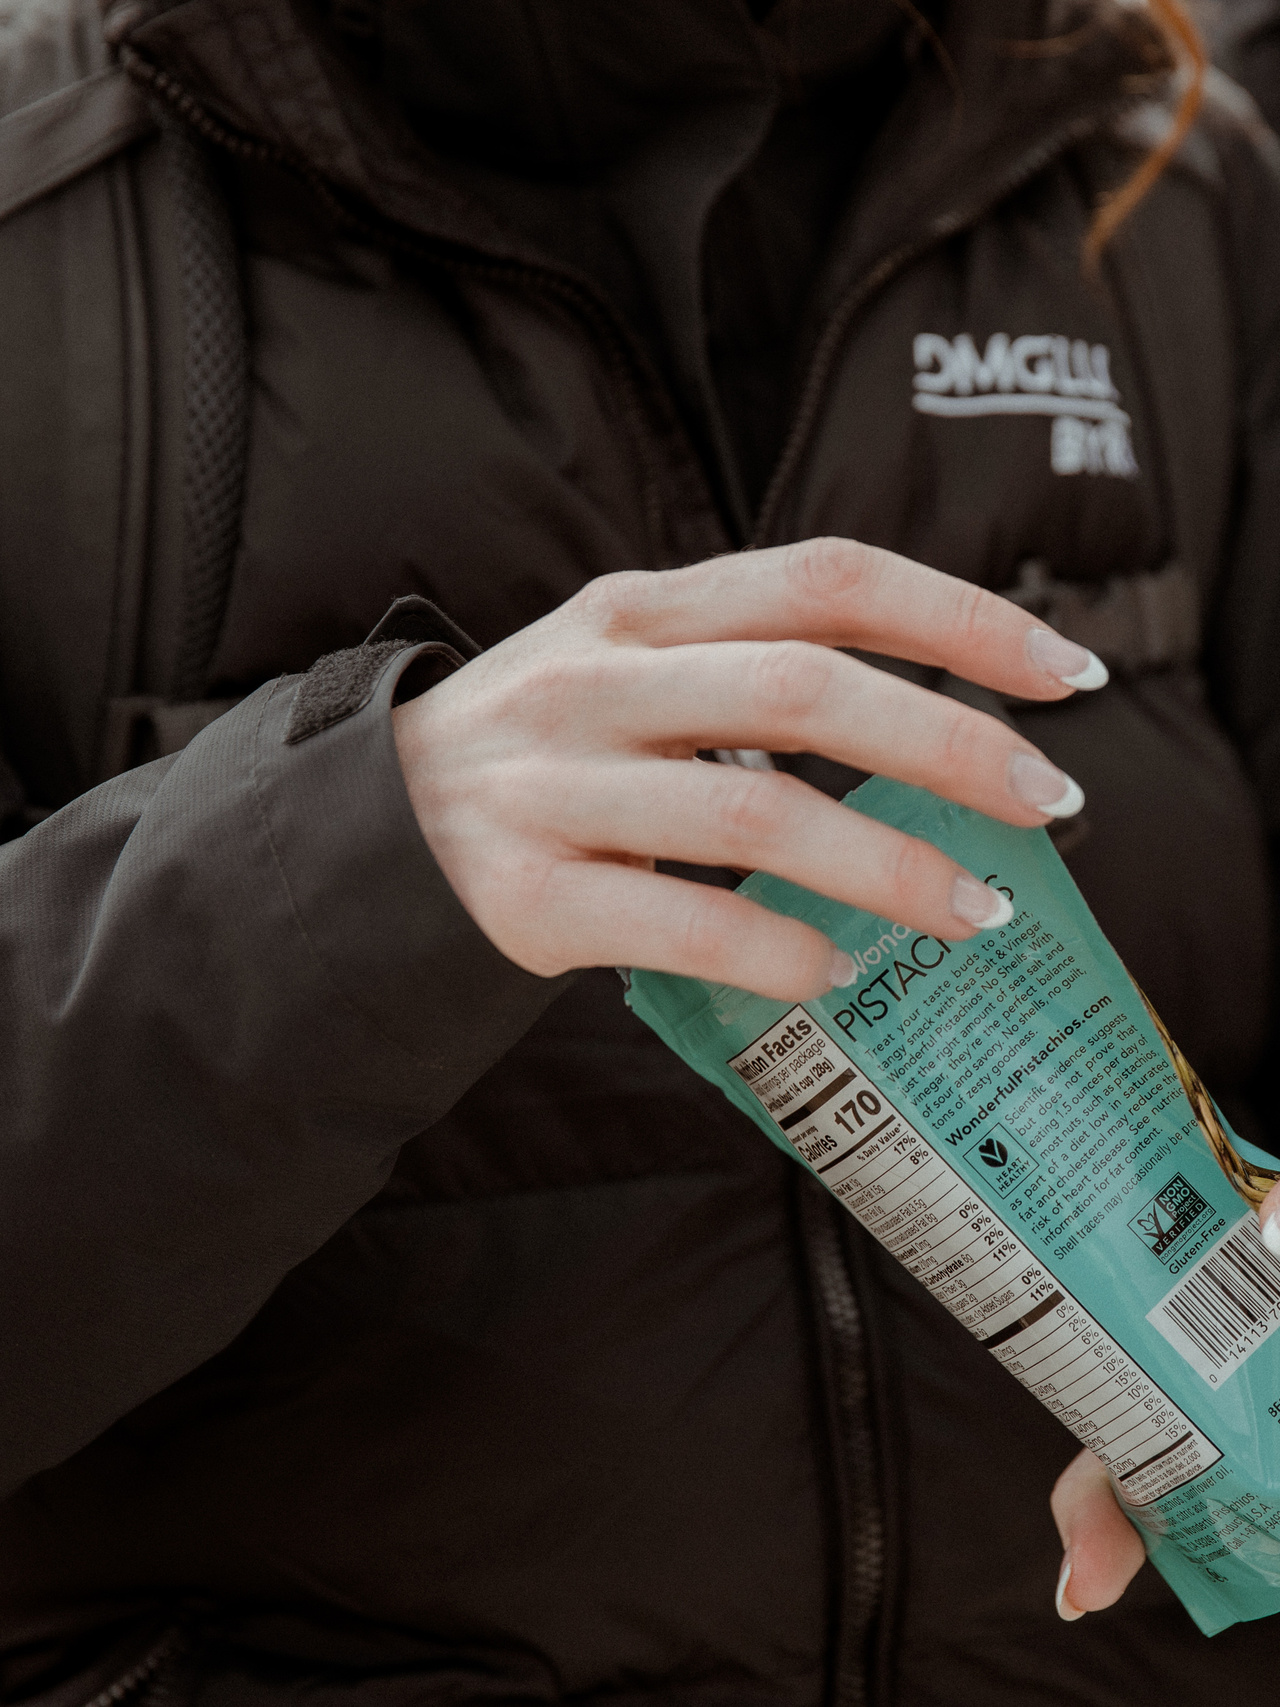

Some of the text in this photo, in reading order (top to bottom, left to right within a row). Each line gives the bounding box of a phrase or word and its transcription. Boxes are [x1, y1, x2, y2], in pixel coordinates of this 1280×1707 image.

[831, 873, 1015, 1044] PISTACS
[863, 910, 1034, 1060] Treat your taste buds to a tart,
[876, 920, 1043, 1072] tangy snack with Sea Salt & Vinegar
[885, 931, 1055, 1083] Wonderful Pistachios No Shells. With
[900, 940, 1066, 1100] just the right amount of sea salt and
[759, 1018, 813, 1064] Facts
[909, 1071, 950, 1107] vinegar,
[982, 1019, 1002, 1038] the
[1001, 984, 1038, 1023] perfect
[1035, 955, 1076, 987] balance
[921, 967, 1088, 1119] of sour and savory. No shells, no guilt,
[776, 1037, 827, 1085] per package
[797, 1074, 816, 1091] cup
[808, 1055, 837, 1083] (28g)
[943, 994, 1113, 1147] WonderfulPistachios.com
[1003, 1012, 1129, 1126] Scientific evidence suggests
[931, 1029, 1039, 1131] tons of zesty goodness.
[1014, 1023, 1139, 1137] but does not prove that
[1028, 1032, 1149, 1149] eating 1.5 ounces per day of
[1039, 1049, 1161, 1161] most nuts, such as pistachios,
[796, 1128, 839, 1164] Calories
[832, 1089, 883, 1136] 170
[1008, 1057, 1170, 1212] as part of a diet low in saturated
[861, 1142, 882, 1159] Daily
[893, 1133, 918, 1156] 17%
[908, 1147, 930, 1166] 8%
[1017, 1206, 1038, 1223] fat
[1035, 1184, 1058, 1209] and
[1055, 1132, 1109, 1189] cholesterol
[1106, 1113, 1130, 1138] may
[1127, 1082, 1165, 1117] reduce
[995, 1156, 1023, 1184] HEART
[997, 1159, 1031, 1193] HEALTHY
[1030, 1214, 1052, 1235] risk
[1050, 1198, 1064, 1216] of
[1061, 1174, 1093, 1203] heart
[1091, 1137, 1131, 1176] disease.
[1127, 1115, 1151, 1136] See
[1039, 1127, 1164, 1247] information for fat content.
[1052, 1118, 1199, 1261] Shell traces may occasionally be pre
[1157, 1178, 1185, 1206] NON
[1165, 1186, 1191, 1213] GMO
[1171, 1194, 1197, 1220] Project
[958, 1200, 980, 1220] 0%
[970, 1213, 993, 1233] 9%
[1154, 1202, 1205, 1252] VERIFIED
[983, 1227, 1005, 1247] 2%
[992, 1240, 1018, 1263] 11%
[1168, 1217, 1227, 1275] Gluten-Free
[1020, 1266, 1043, 1286] 0%
[1029, 1280, 1055, 1302] 11%
[1055, 1302, 1075, 1320] 0%
[1067, 1315, 1088, 1334] 2%
[1080, 1330, 1100, 1346] 6%
[1092, 1344, 1113, 1359] 6%
[1208, 1373, 1219, 1385] 0
[1228, 1319, 1269, 1361] 14113
[1101, 1356, 1125, 1375] 10%
[1114, 1370, 1138, 1388] 15%
[1126, 1382, 1151, 1401] 10%
[1142, 1397, 1163, 1412] 6%
[1150, 1408, 1176, 1429] 30%
[1164, 1423, 1188, 1441] 15%
[1214, 1464, 1235, 1481] oil,
